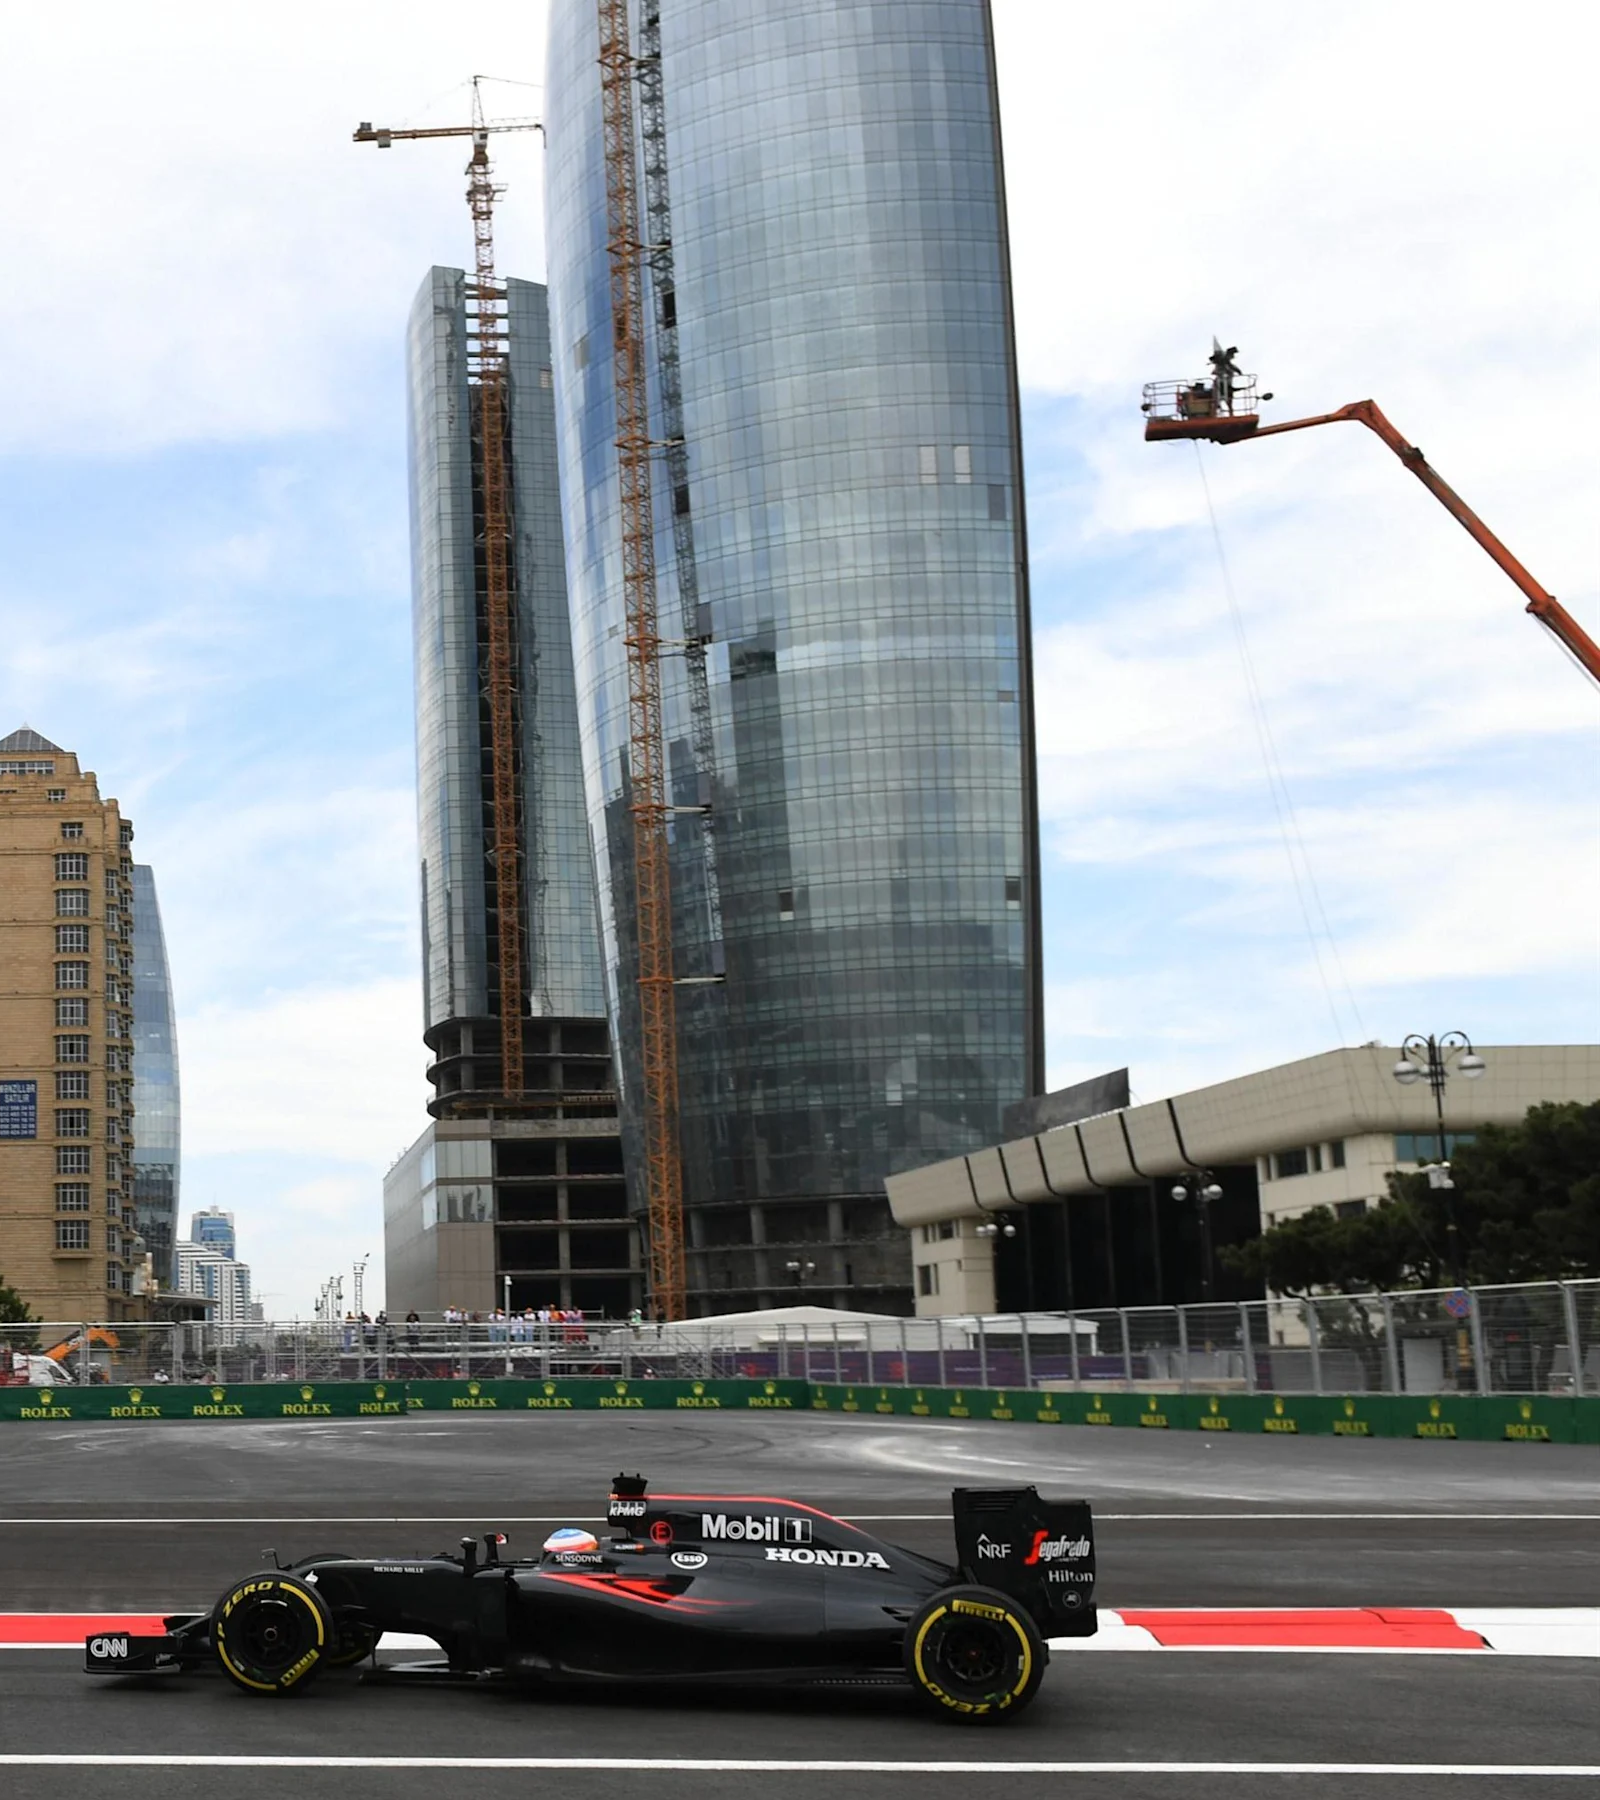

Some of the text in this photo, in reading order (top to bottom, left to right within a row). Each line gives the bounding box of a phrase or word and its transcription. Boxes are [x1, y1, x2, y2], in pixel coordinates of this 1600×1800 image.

[359, 1402, 400, 1413] ROLEX
[453, 1397, 496, 1408] ROLEX
[528, 1397, 572, 1408] ROLEX
[599, 1397, 643, 1407] ROLEX
[676, 1397, 720, 1407] ROLEX
[748, 1397, 791, 1407] ROLEX
[20, 1407, 71, 1418] ROLEX
[110, 1406, 160, 1417] ROLEX
[193, 1404, 243, 1416] ROLEX
[282, 1403, 331, 1415] ROLEX
[609, 1503, 646, 1516] KPMG
[702, 1514, 780, 1541] Mobil
[978, 1543, 1011, 1559] NRF
[1024, 1530, 1091, 1565] Segafredo
[555, 1553, 603, 1564] SENSODYNE
[765, 1547, 890, 1569] HONDA
[1048, 1569, 1094, 1582] Hilton
[222, 1581, 274, 1618] ZERO
[952, 1599, 1005, 1621] PIRELLI
[90, 1638, 128, 1658] CNN
[926, 1682, 991, 1714] ZERO
